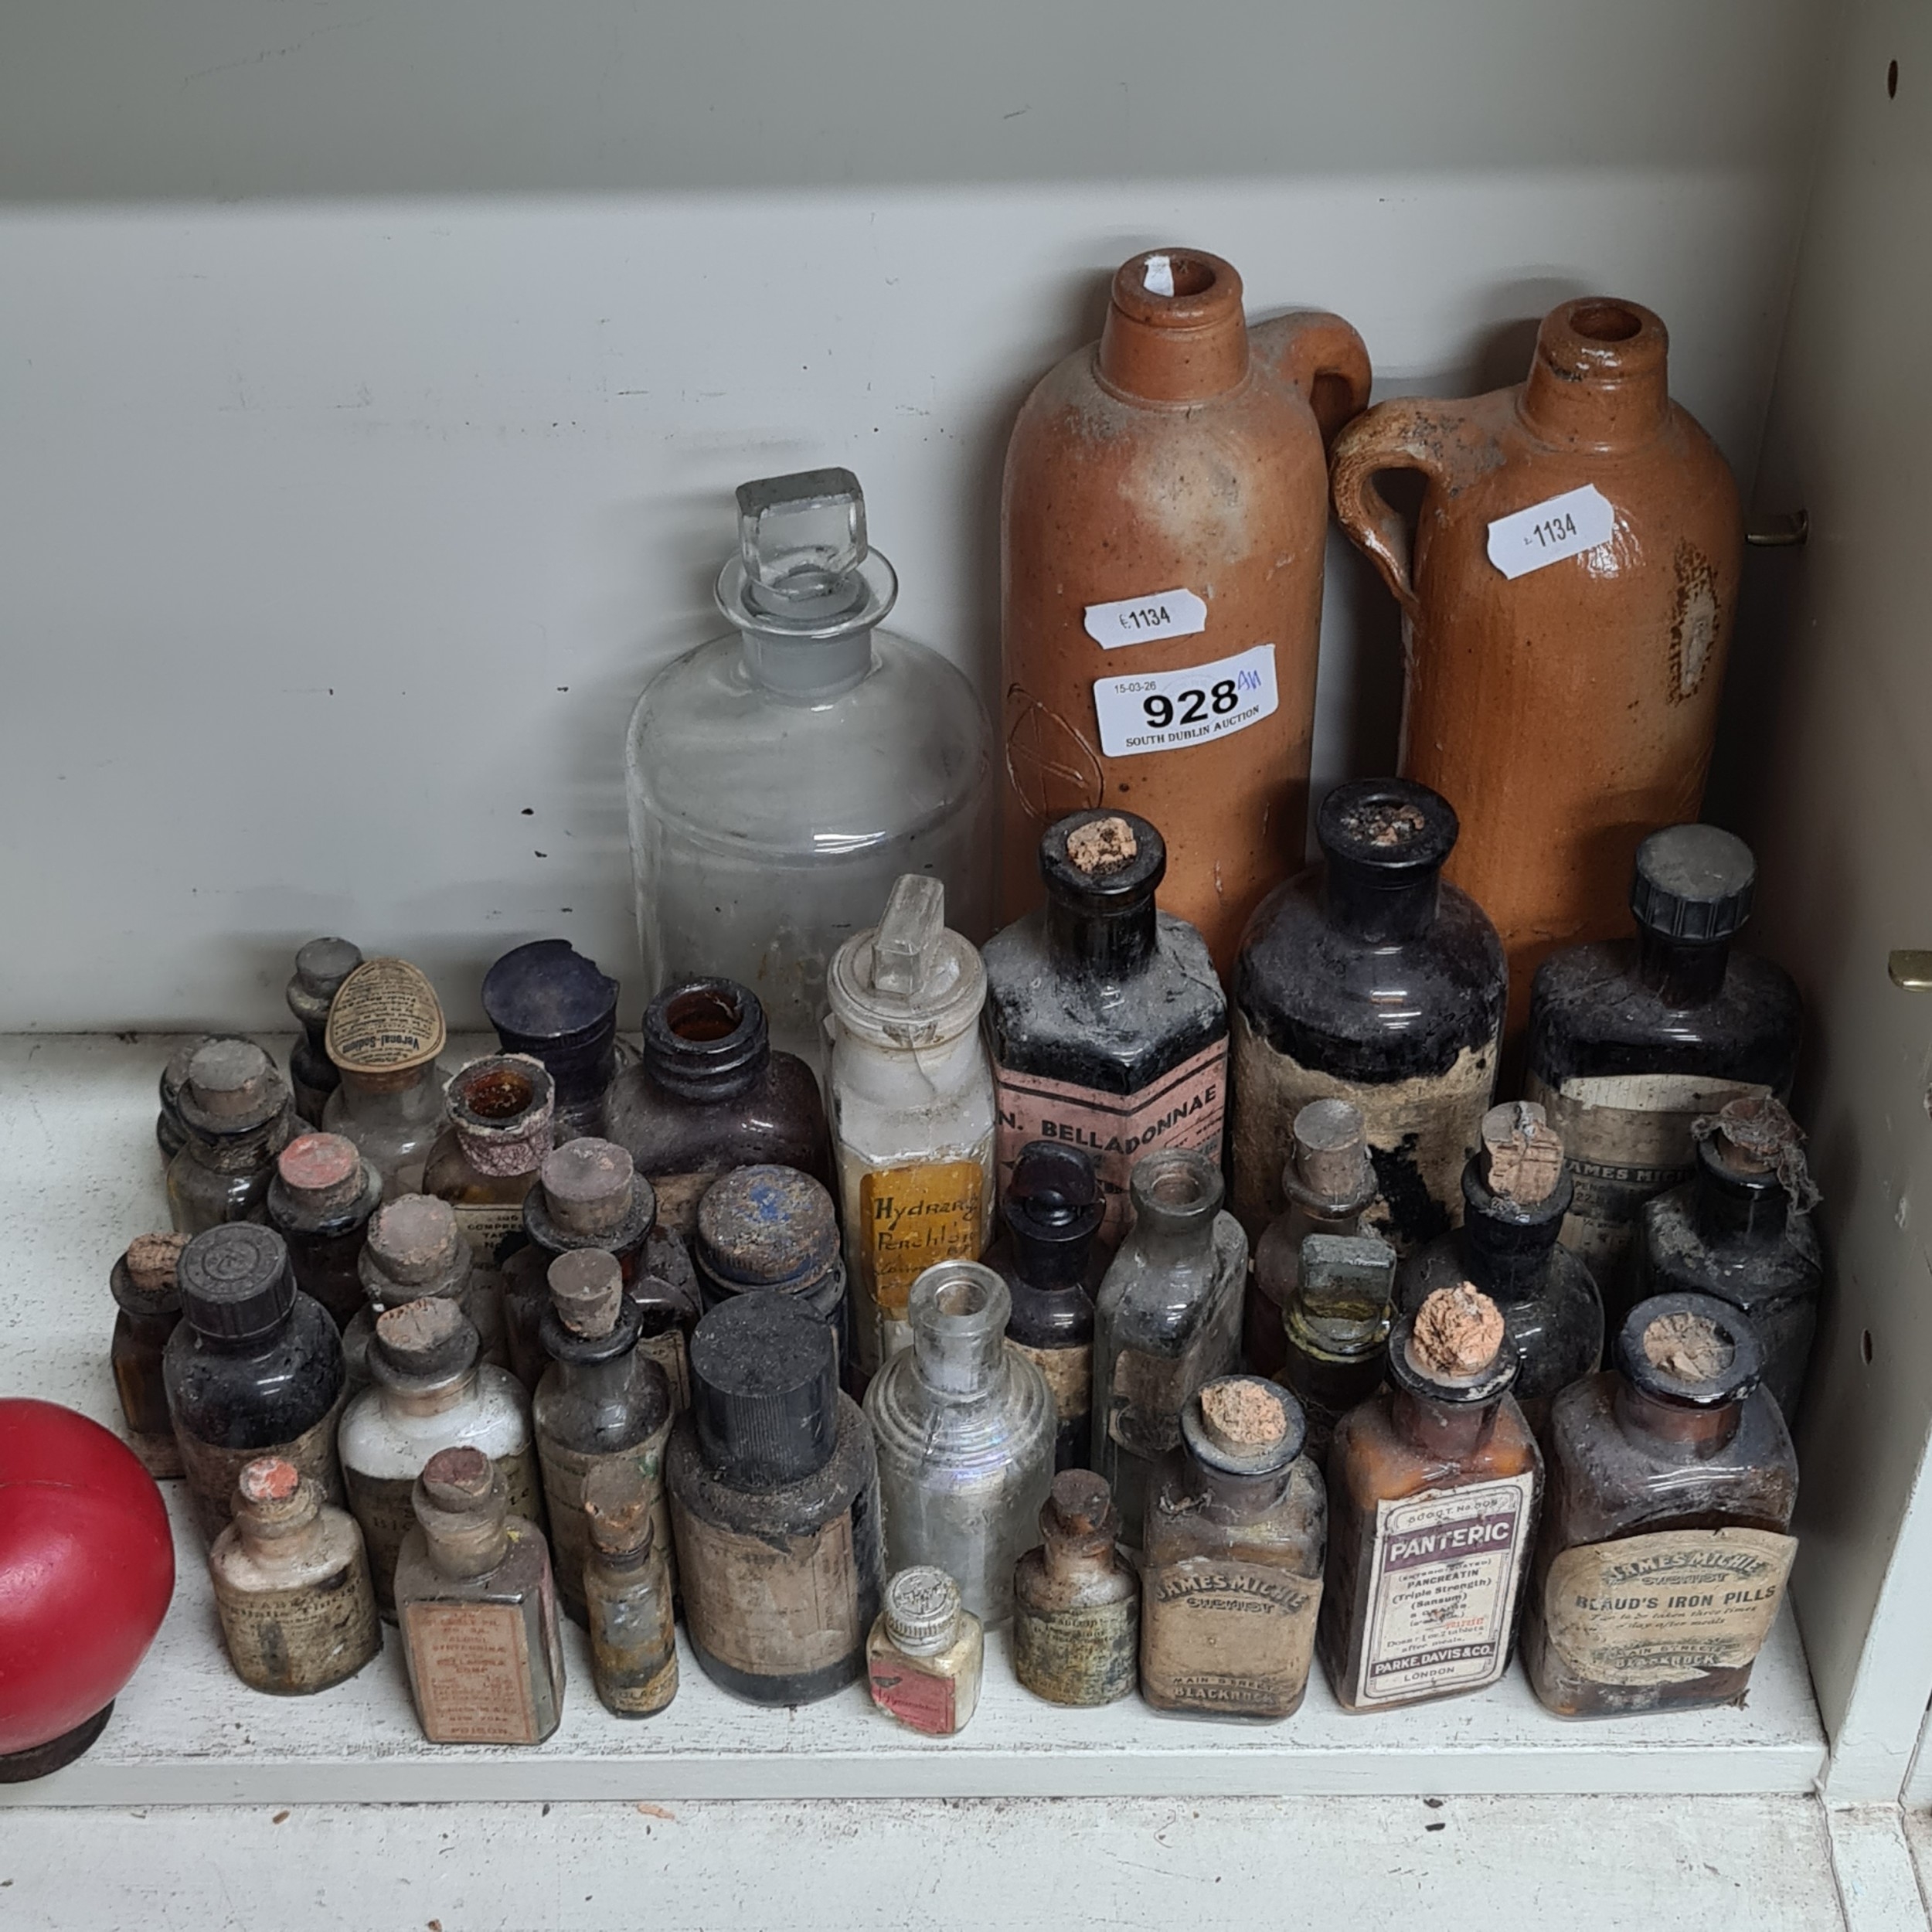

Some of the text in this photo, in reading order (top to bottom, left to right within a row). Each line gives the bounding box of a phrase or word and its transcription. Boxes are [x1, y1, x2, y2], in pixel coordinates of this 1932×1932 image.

[1114, 681, 1157, 693] 15-03-26
[1143, 680, 1239, 729] 928
[1126, 705, 1260, 747] SOUTH DUBLIN AUCTION
[1042, 1084, 1217, 1155] BELLADONNAE
[1390, 1522, 1510, 1562] PANTERIC
[1158, 1575, 1227, 1602] JAMES
[1392, 1577, 1492, 1604] (Triple Strength)
[1407, 1569, 1480, 1589] PANCREATIN
[1411, 1593, 1468, 1610] (Sansum)
[1577, 1585, 1777, 1611] BLAUD'S IRON PILLS
[1404, 1667, 1455, 1682] LONDON
